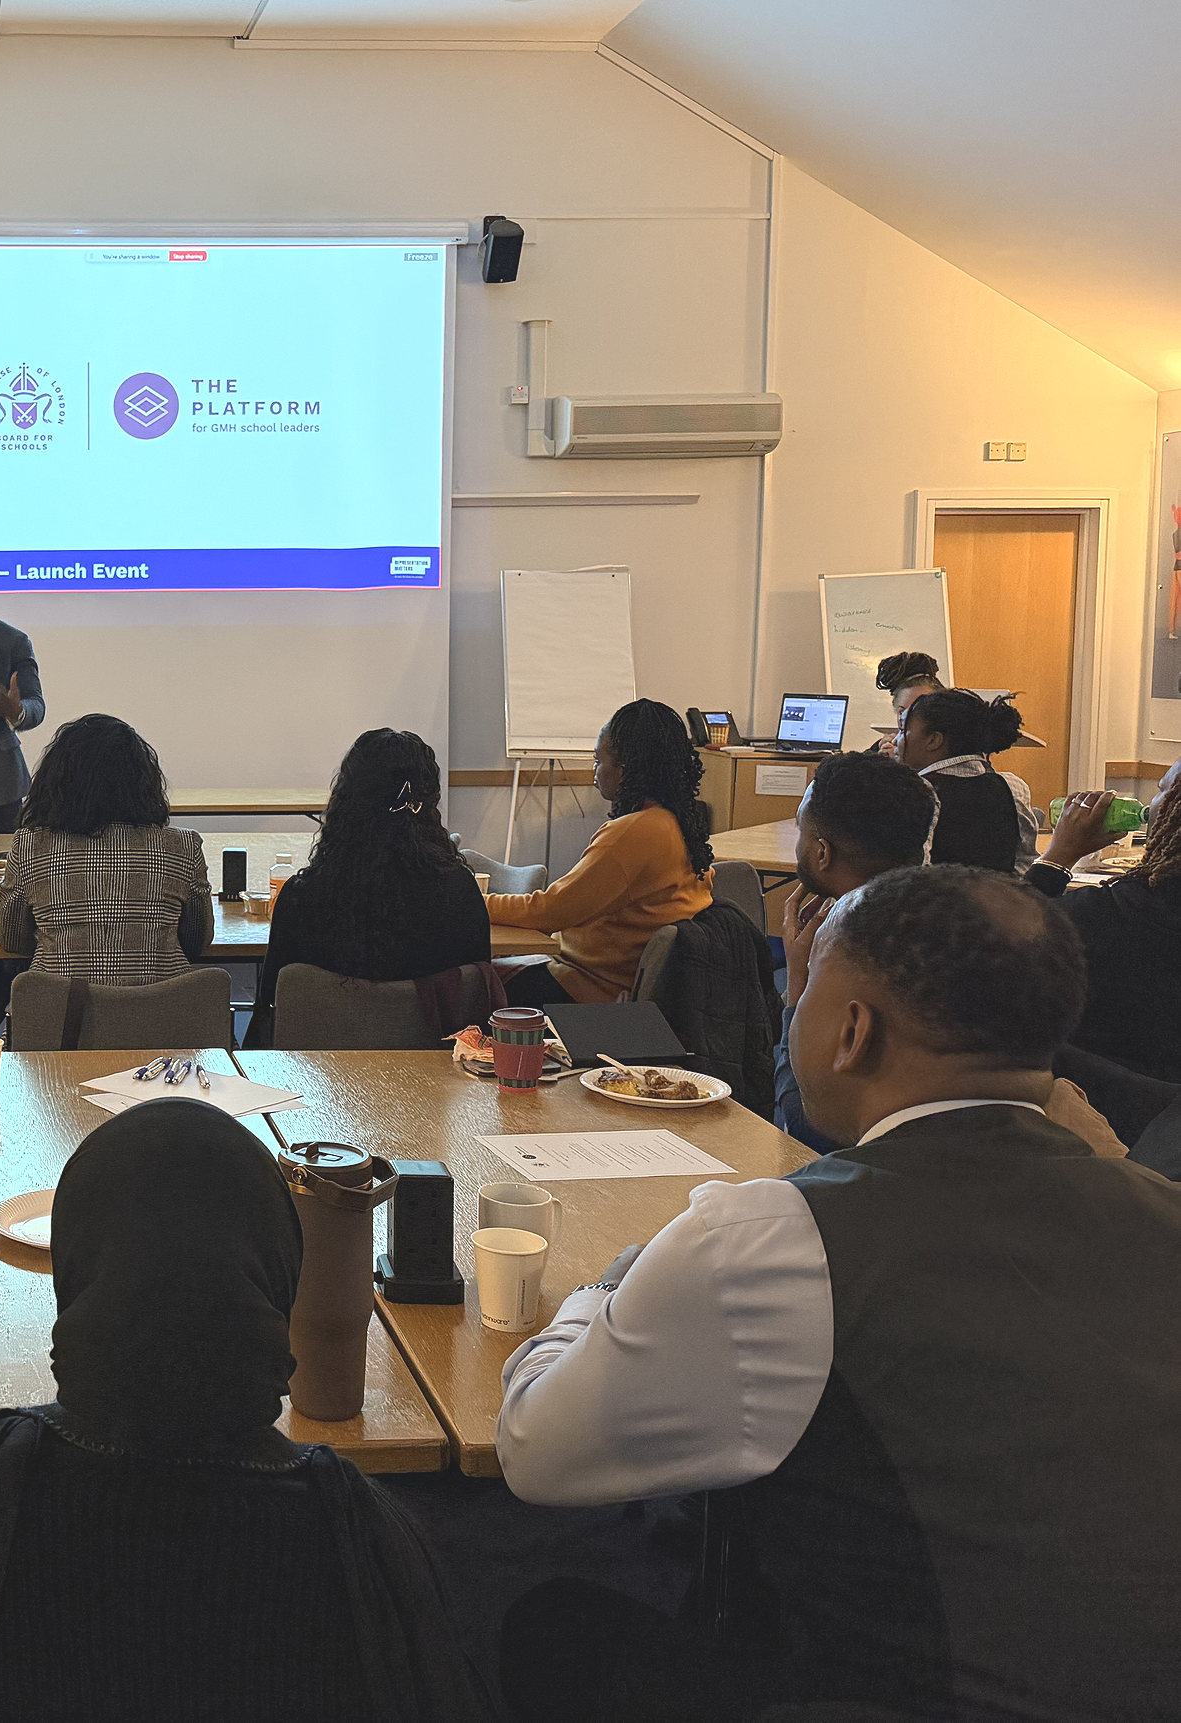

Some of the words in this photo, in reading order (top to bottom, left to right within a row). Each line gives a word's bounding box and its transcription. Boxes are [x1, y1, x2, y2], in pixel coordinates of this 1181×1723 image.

[191, 379, 238, 393] THE
[36, 367, 50, 377] OF
[51, 380, 66, 425] LONDON
[192, 401, 320, 415] PLATFORM
[192, 423, 207, 432] for
[211, 423, 237, 432] GMH
[241, 423, 276, 432] school
[280, 423, 320, 432] leaders
[16, 562, 87, 580] Launch
[93, 562, 149, 579] Event
